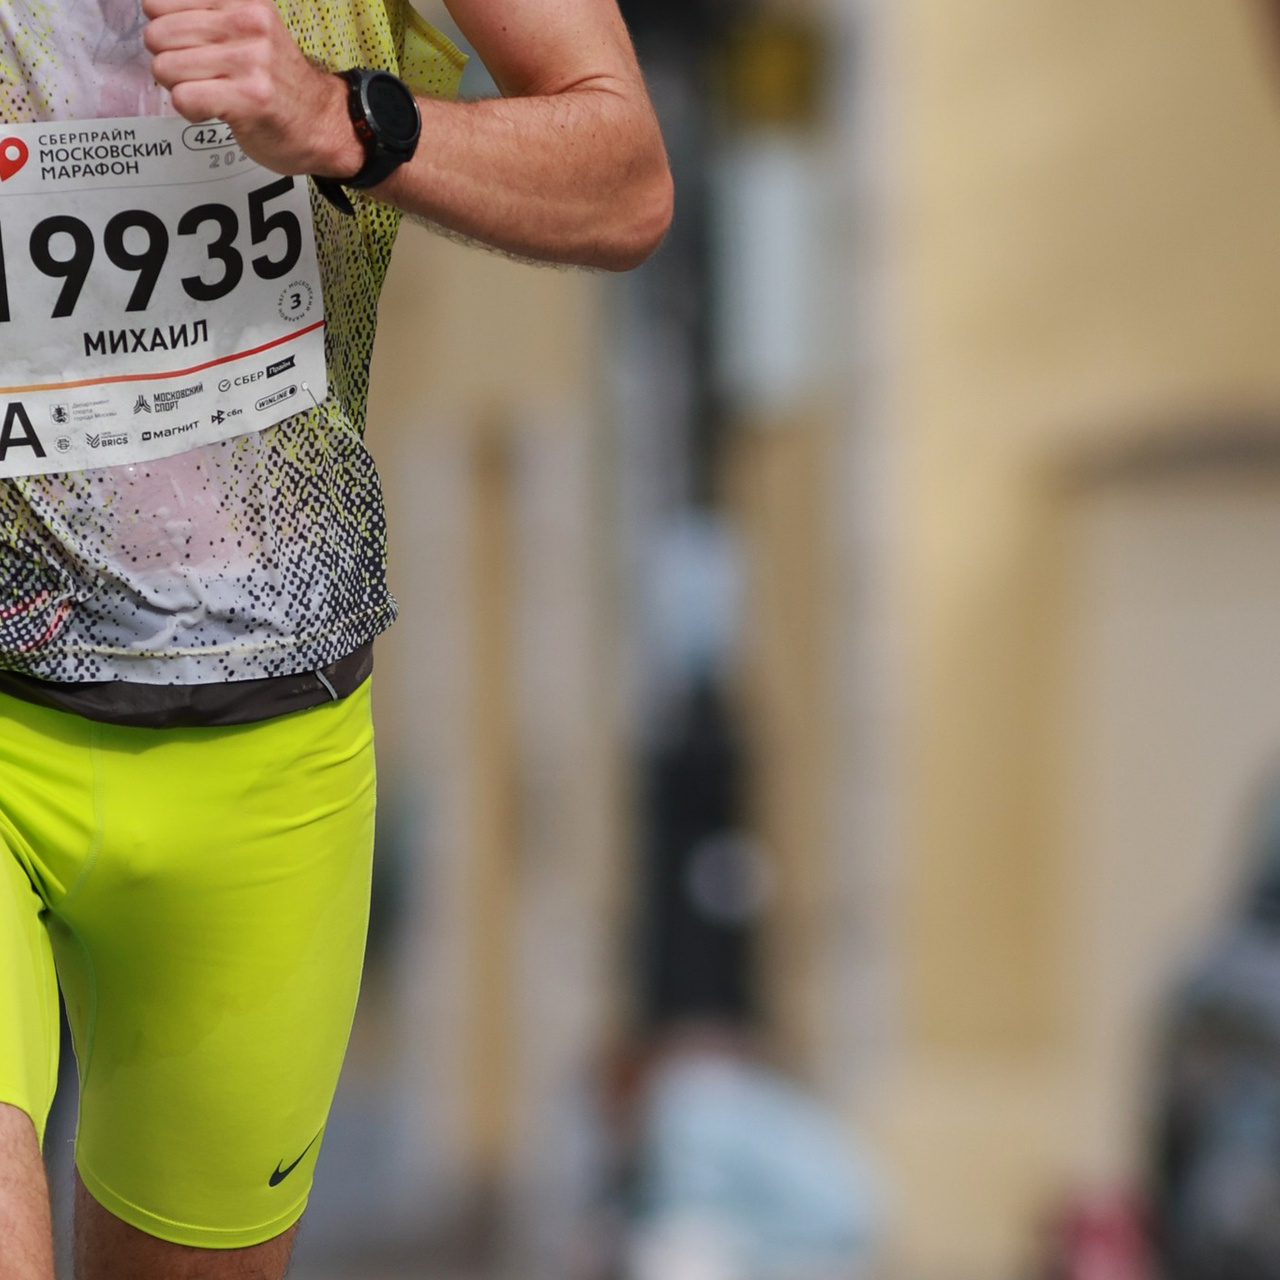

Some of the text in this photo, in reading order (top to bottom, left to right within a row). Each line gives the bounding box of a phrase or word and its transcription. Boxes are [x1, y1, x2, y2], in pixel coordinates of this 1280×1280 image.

[38, 128, 136, 146] СБЕРПРАЙМ
[40, 139, 173, 163] МОСКОВСКИЙ
[41, 161, 140, 180] МАРАФОН
[290, 293, 302, 310] 3
[83, 319, 208, 357] МИХАИЛ
[233, 370, 265, 387] СБЕР
[153, 382, 204, 402] МОСКОВСКИЙ
[154, 400, 179, 413] СПОРТ
[226, 408, 244, 418] сбп
[101, 436, 128, 447] BRICS
